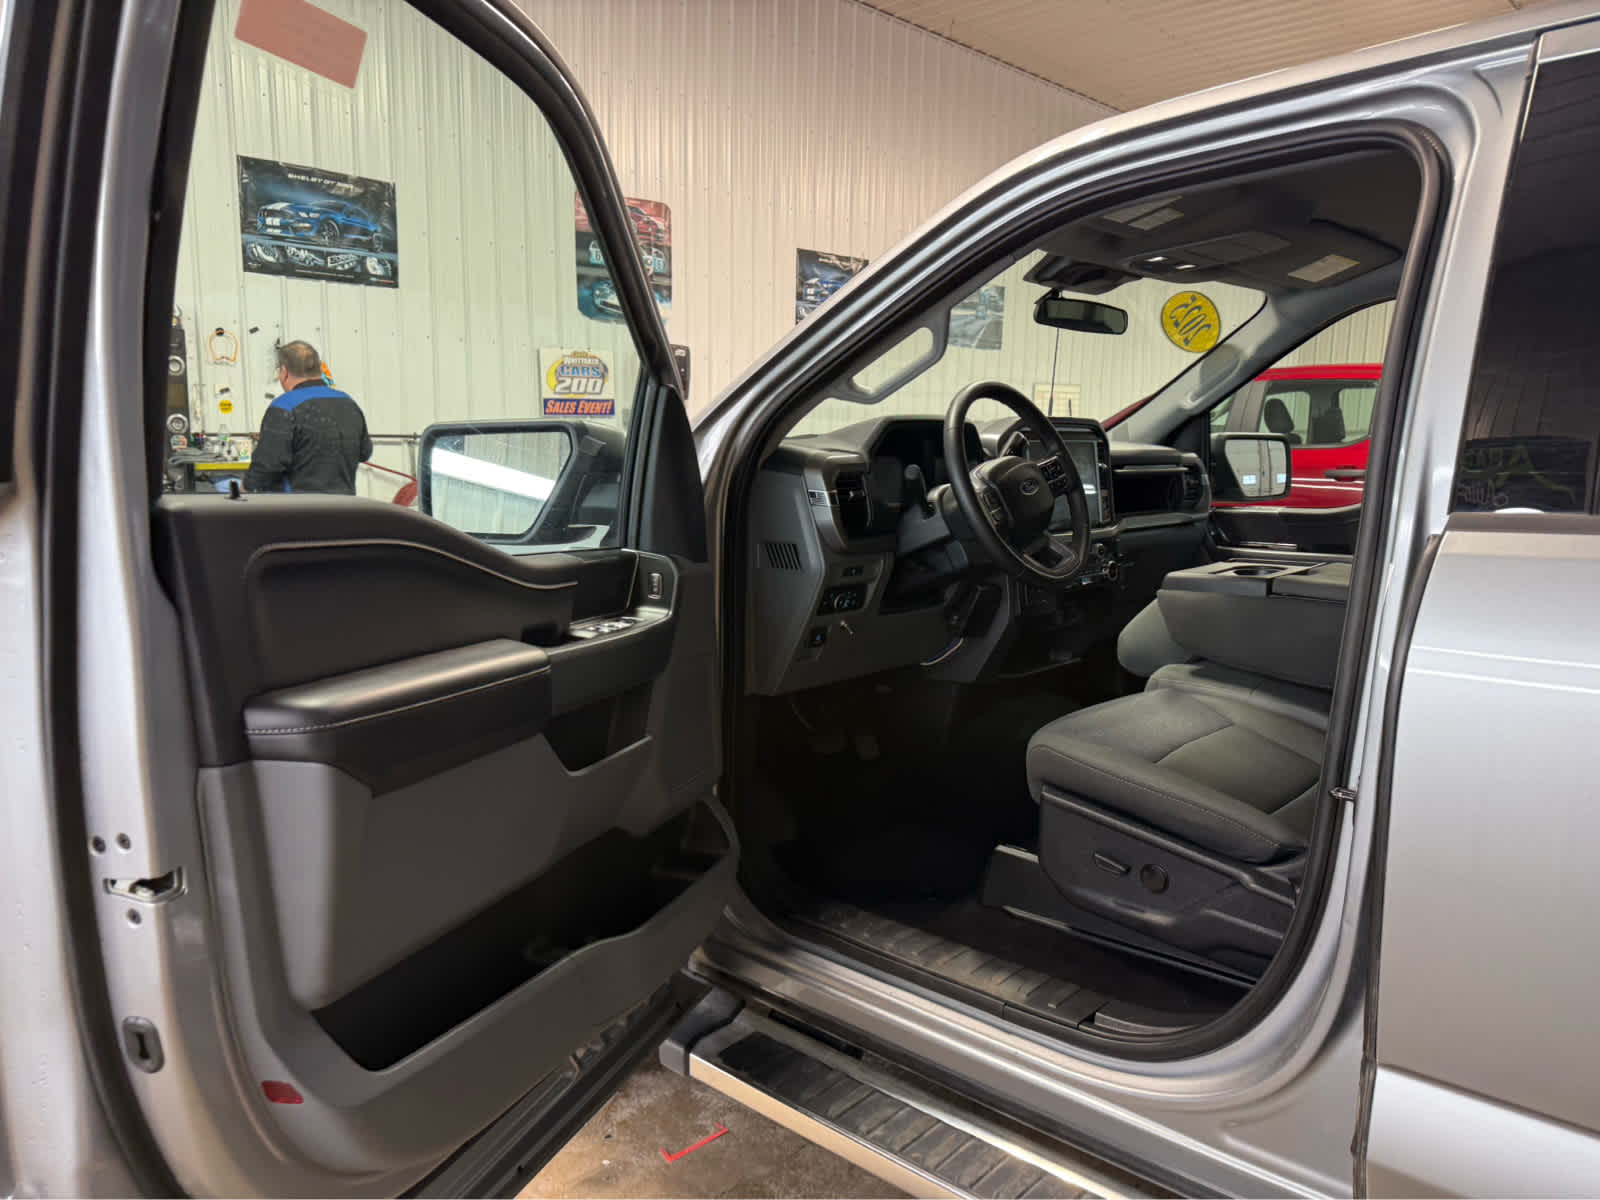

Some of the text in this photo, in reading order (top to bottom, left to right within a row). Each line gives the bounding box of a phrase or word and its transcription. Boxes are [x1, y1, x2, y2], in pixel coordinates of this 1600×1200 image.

[560, 366, 601, 377] CARS
[554, 377, 605, 395] 200
[546, 400, 612, 414] SALES EVENT!
